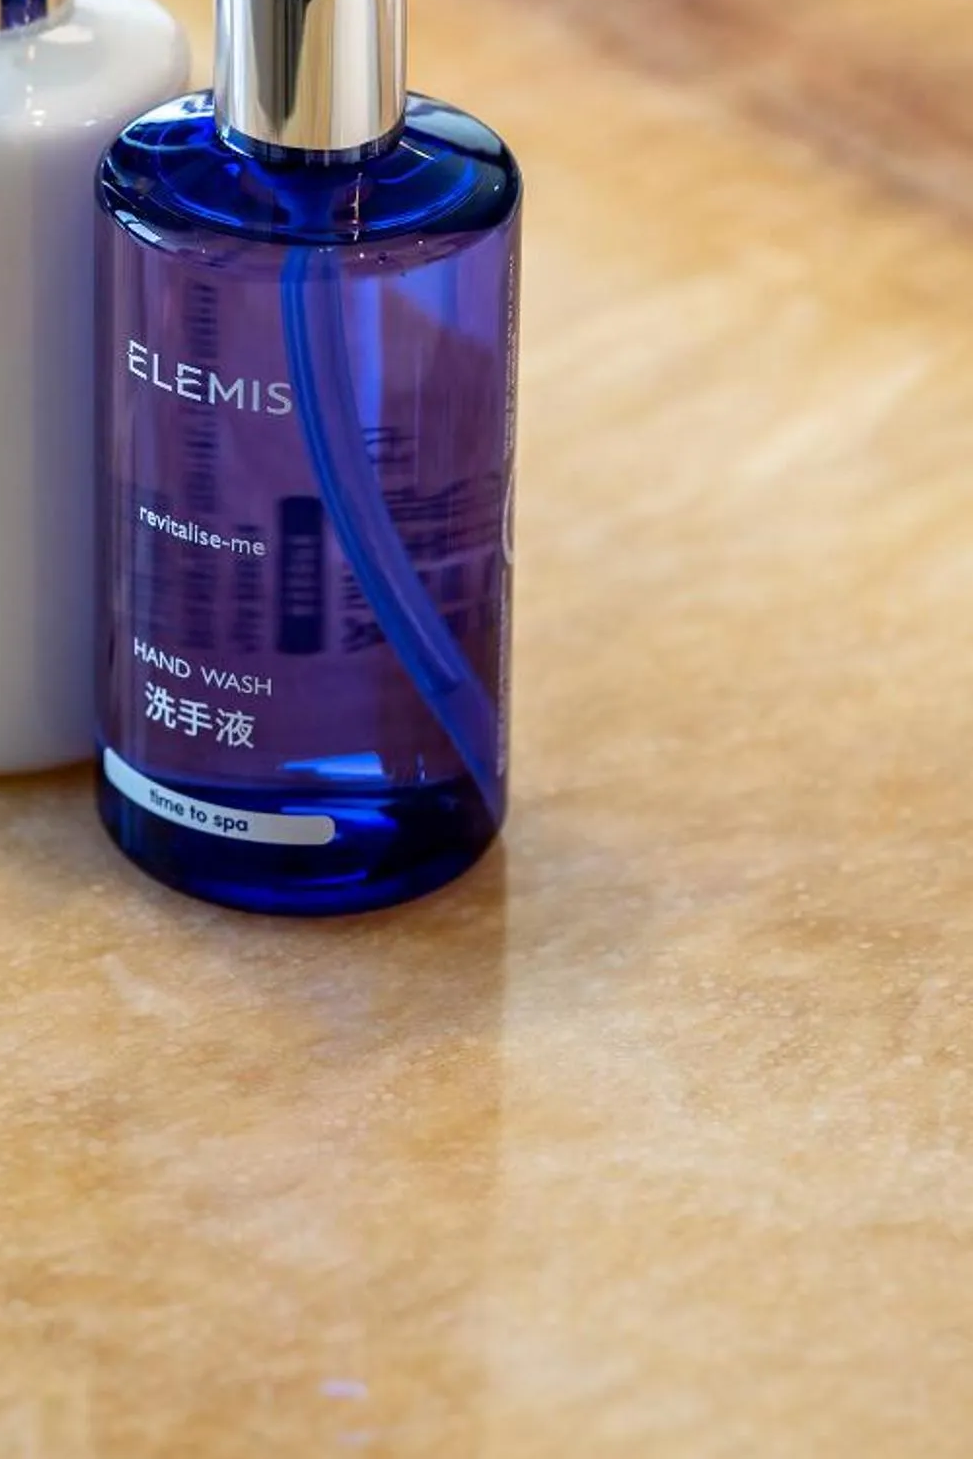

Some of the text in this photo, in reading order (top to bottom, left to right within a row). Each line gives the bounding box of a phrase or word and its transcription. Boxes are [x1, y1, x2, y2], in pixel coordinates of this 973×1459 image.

[128, 339, 292, 415] ELEMIS
[139, 506, 265, 555] revitalise-me
[134, 637, 272, 696] HAND WASH
[144, 682, 254, 748] 洗手液
[149, 788, 249, 833] time to spa
